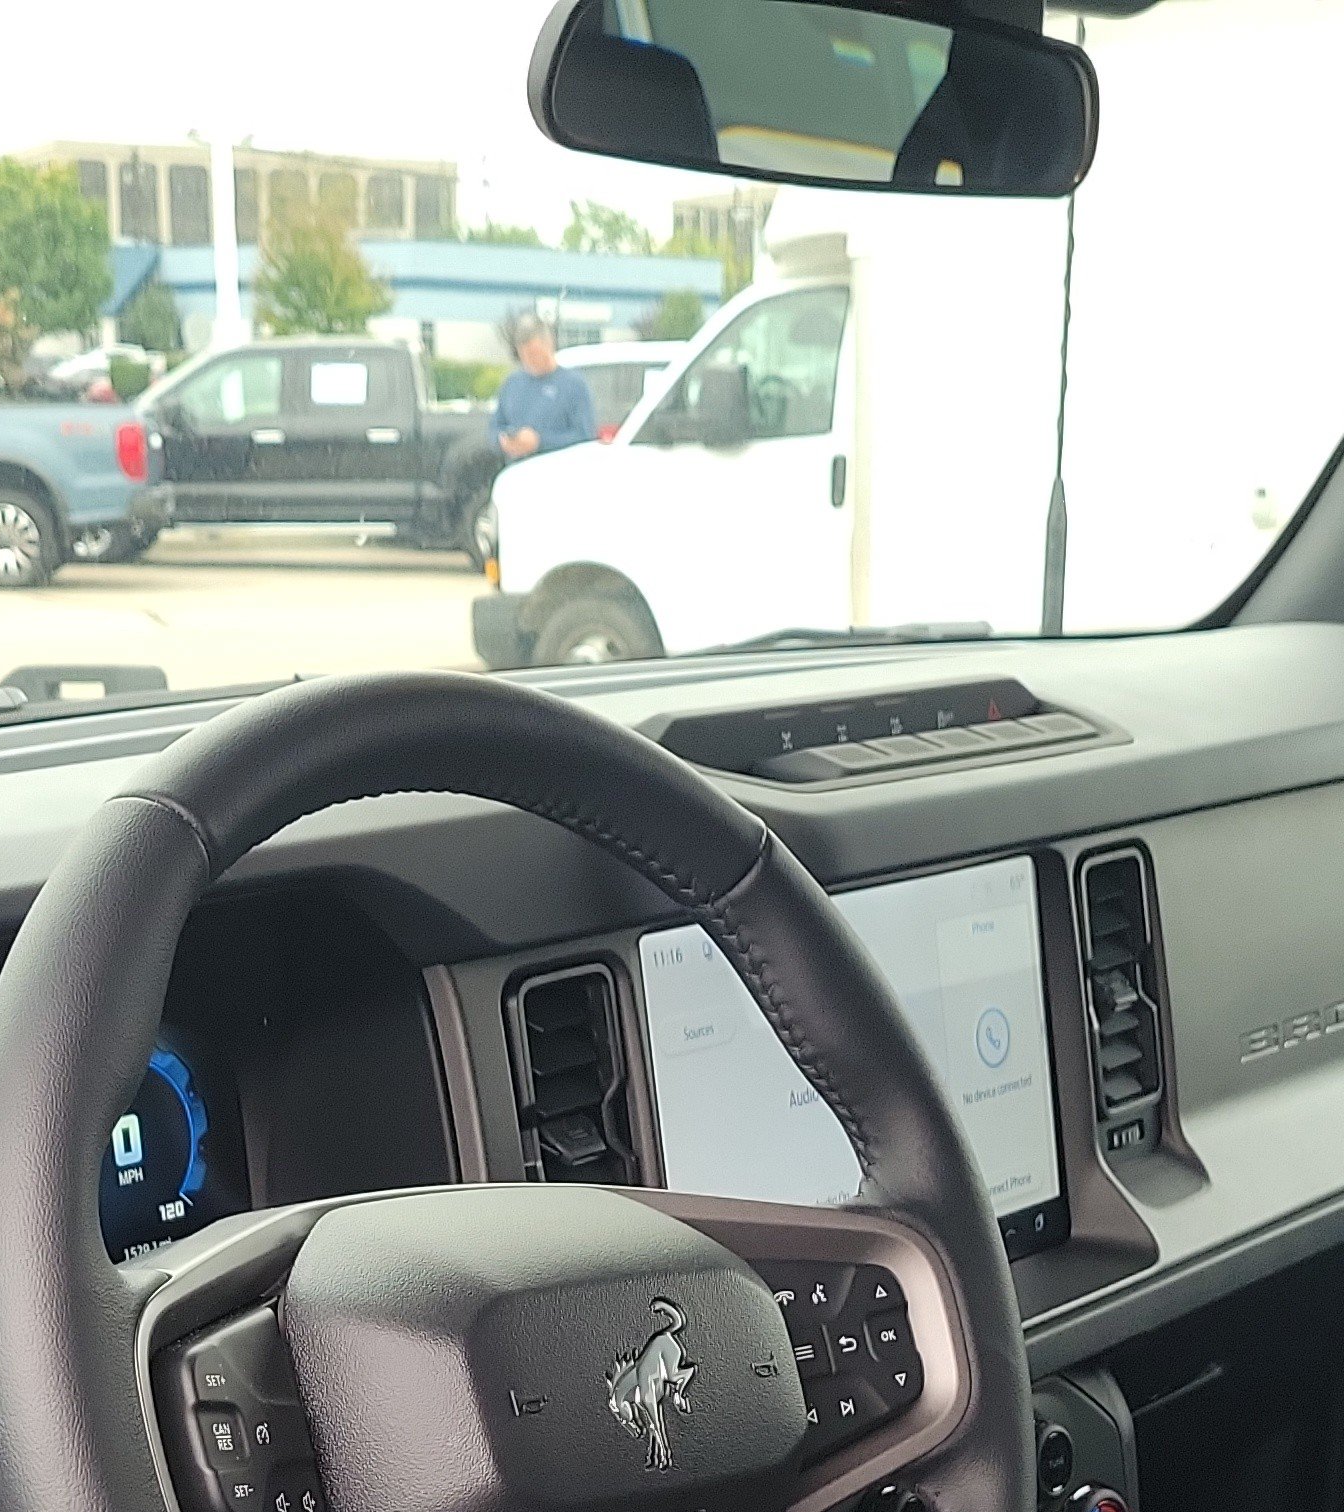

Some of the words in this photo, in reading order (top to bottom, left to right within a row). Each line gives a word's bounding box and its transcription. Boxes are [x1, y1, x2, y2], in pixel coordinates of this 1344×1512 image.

[118, 1166, 144, 1187] MPH
[158, 1200, 185, 1221] 120
[880, 1328, 897, 1342] OK
[212, 1422, 231, 1436] CAN
[217, 1438, 235, 1451] RES
